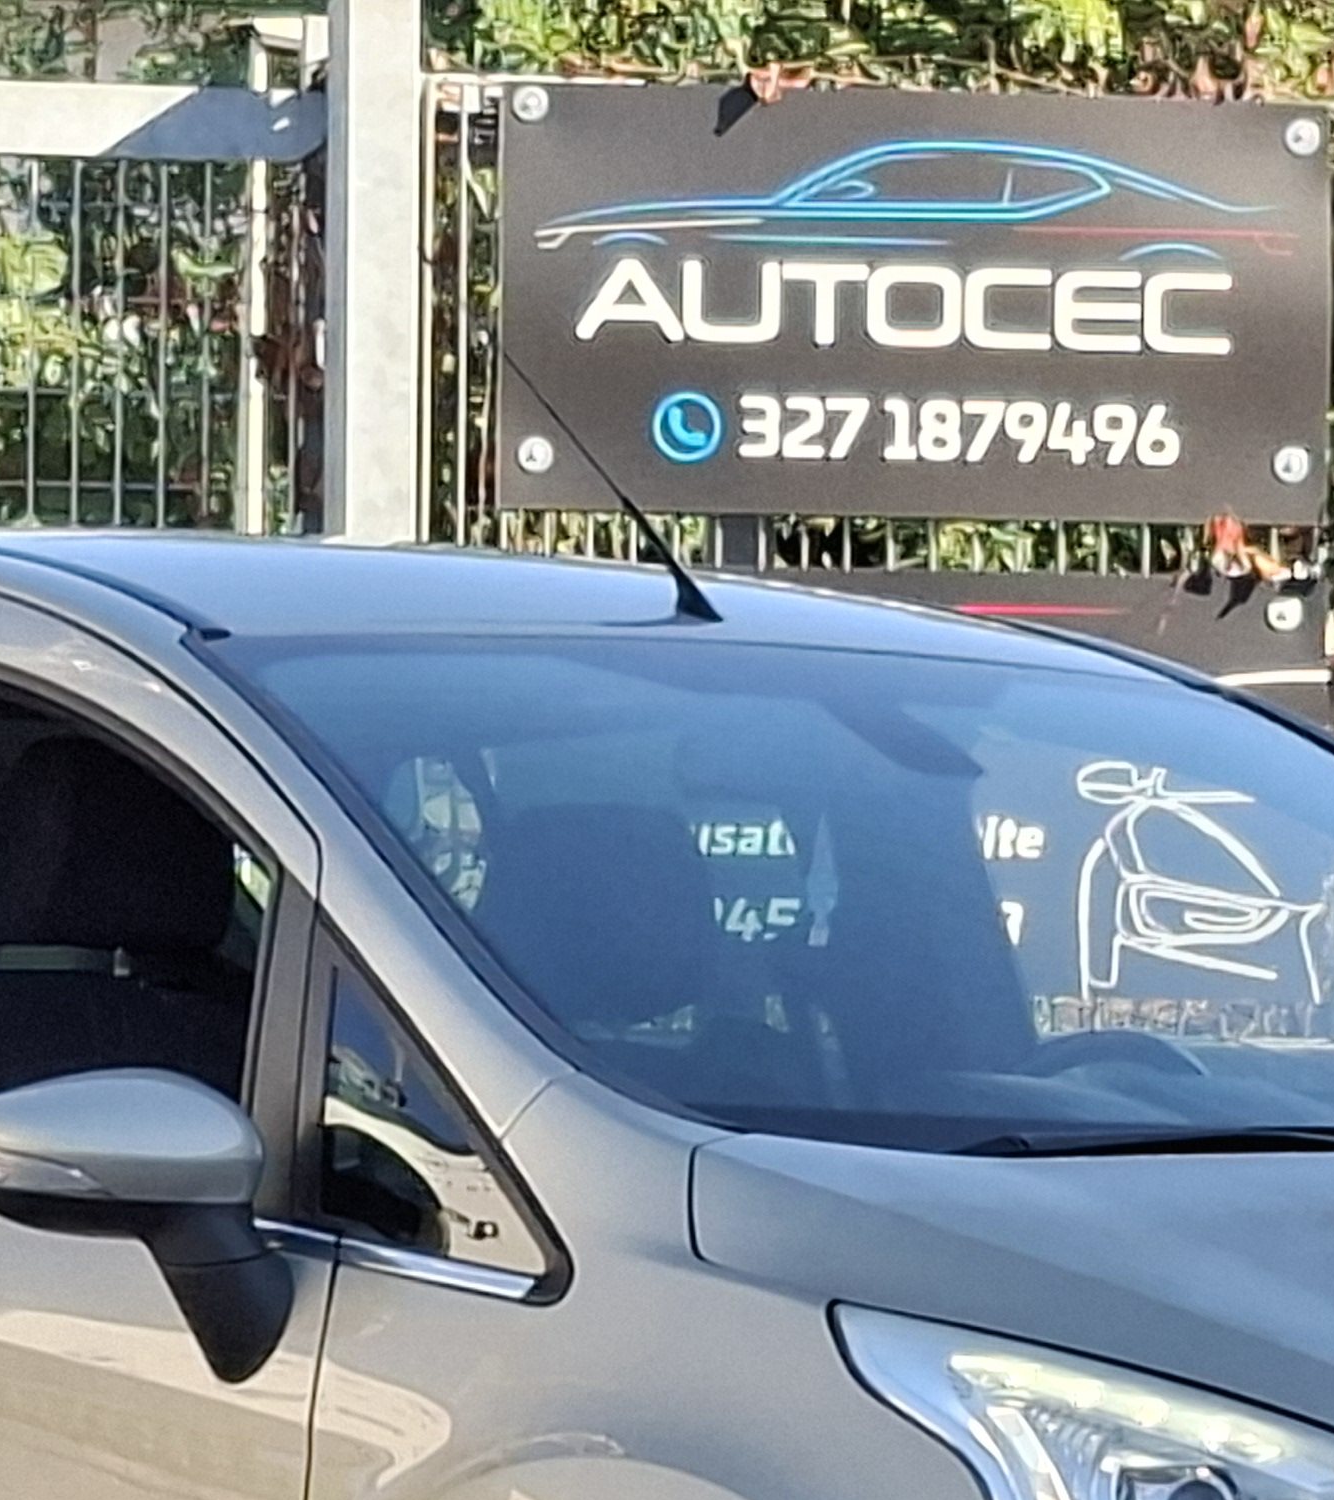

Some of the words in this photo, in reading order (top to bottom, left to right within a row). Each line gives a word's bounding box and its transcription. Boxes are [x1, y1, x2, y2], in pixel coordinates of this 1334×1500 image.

[575, 258, 1233, 355] AUTOCEC
[738, 394, 869, 461] 327
[882, 398, 1181, 466] 1879496
